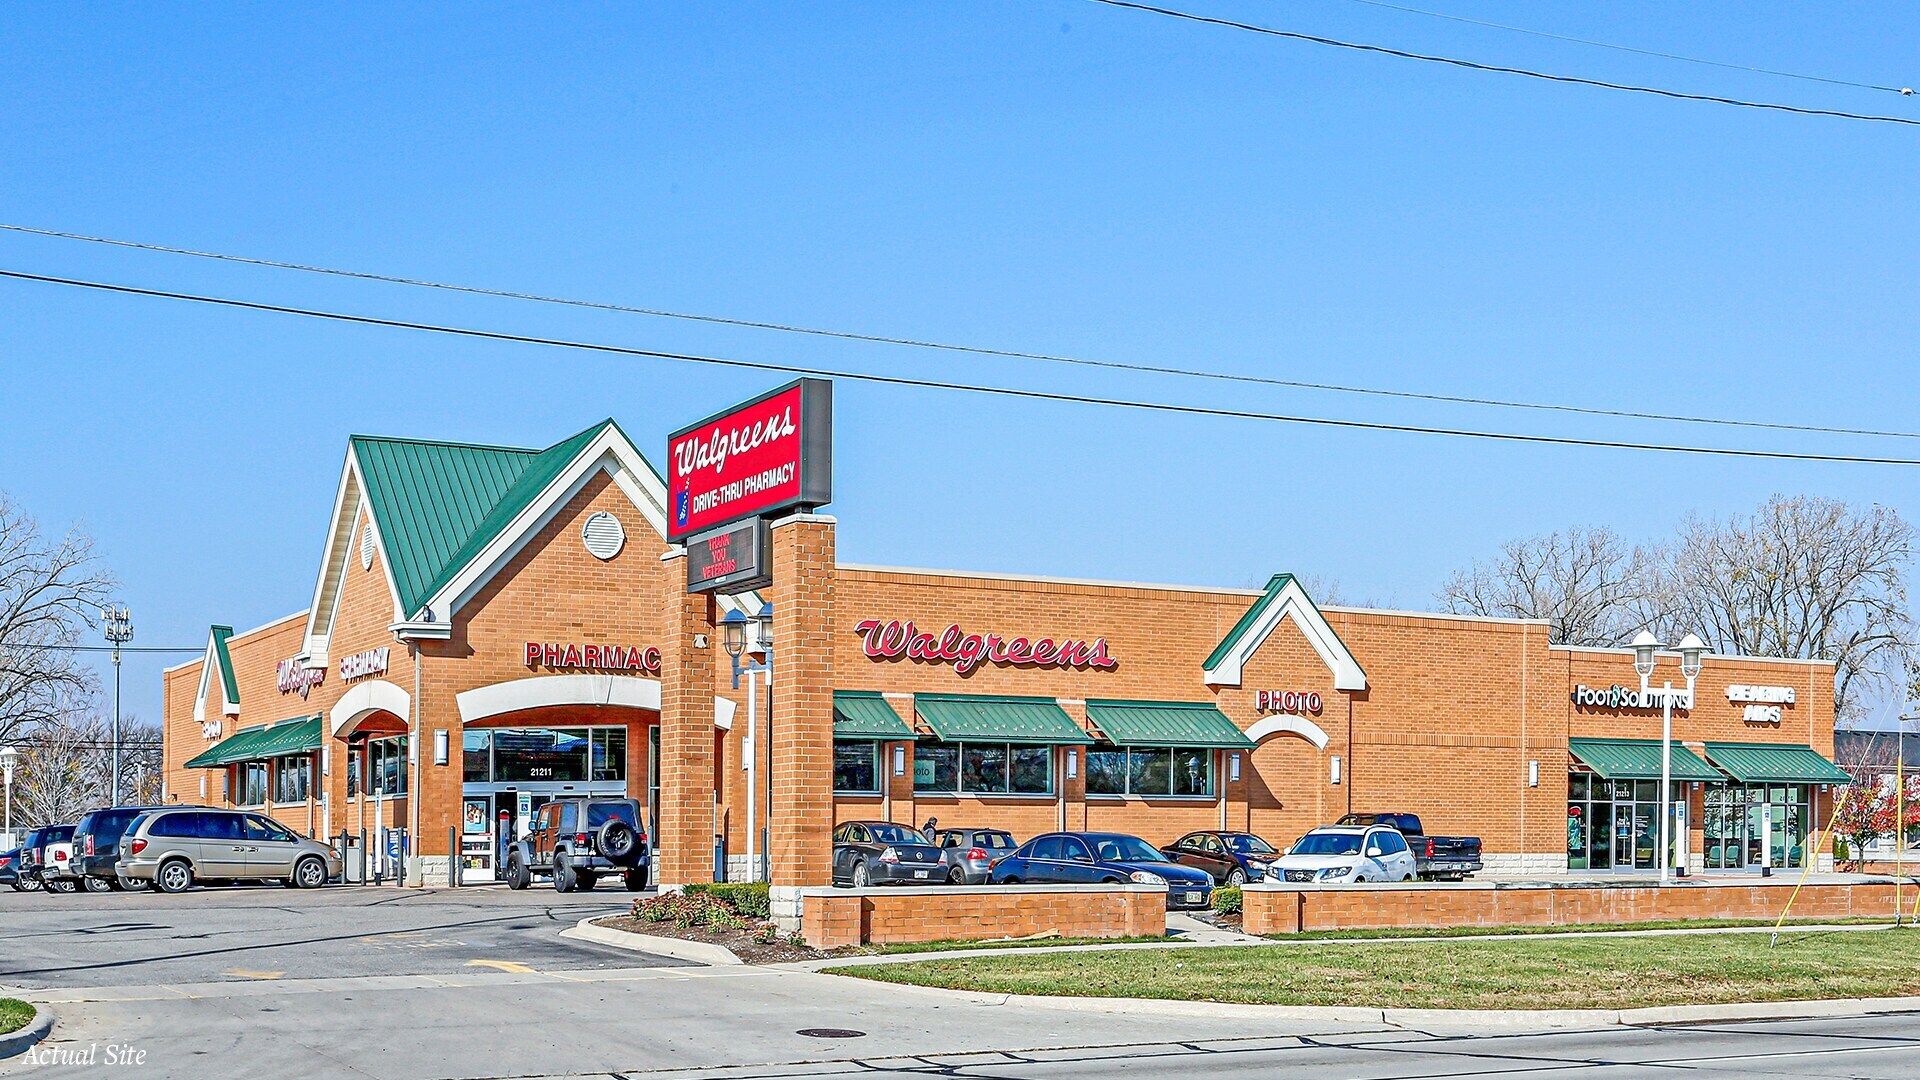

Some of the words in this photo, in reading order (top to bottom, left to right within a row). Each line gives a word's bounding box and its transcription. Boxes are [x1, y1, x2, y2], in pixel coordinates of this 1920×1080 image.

[674, 405, 796, 477] Walgreens
[692, 483, 743, 514] DRIVE-THRU
[744, 461, 796, 496] PHARMACY
[708, 533, 731, 551] THANK
[712, 548, 726, 563] YOU
[702, 559, 737, 579] VETERANS
[524, 641, 661, 671] PHARMAC
[853, 619, 1117, 673] Walgreens
[1255, 690, 1321, 712] PHOTO
[1743, 704, 1781, 722] AIDS
[530, 767, 552, 777] 21211
[913, 768, 930, 776] oto
